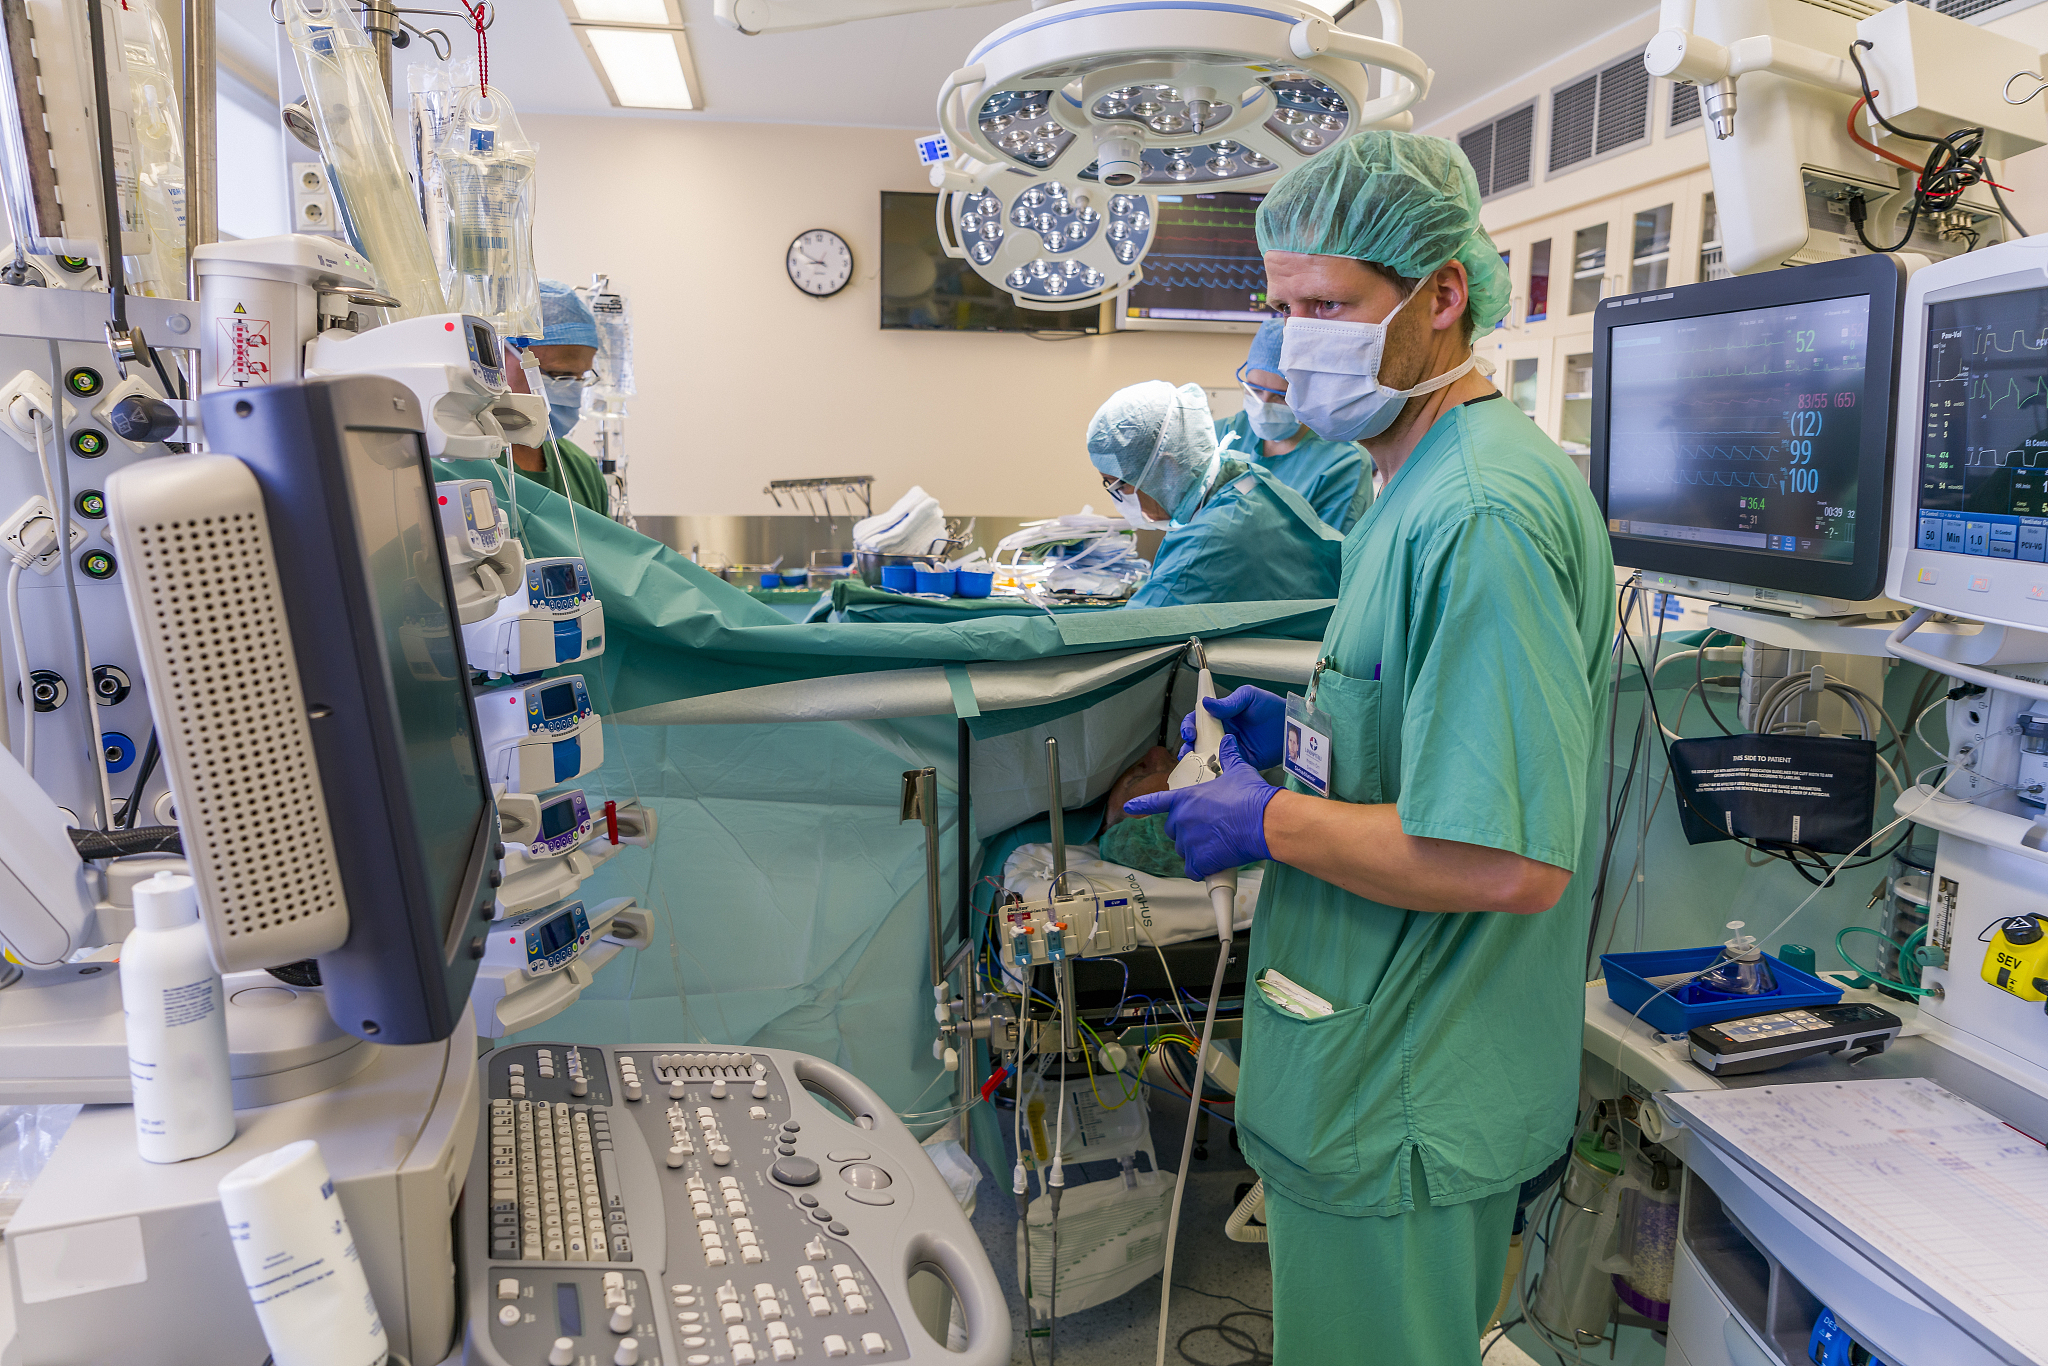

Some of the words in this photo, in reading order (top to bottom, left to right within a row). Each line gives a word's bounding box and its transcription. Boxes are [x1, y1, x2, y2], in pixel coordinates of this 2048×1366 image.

[1796, 330, 1816, 353] 52
[1798, 393, 1828, 409] 83/55
[1834, 392, 1856, 408] (65)
[1790, 411, 1822, 437] (12)
[1790, 440, 1812, 465] 99
[1788, 468, 1819, 494] 100
[1747, 497, 1766, 510] 36.4
[1824, 506, 1843, 518] 00:39
[1750, 515, 1758, 525] 31
[1925, 530, 1935, 540] 50
[1946, 532, 1960, 543] Min
[1970, 535, 1983, 545] 1.0
[2021, 541, 2043, 551] PCV-VG
[1767, 755, 1792, 763] PATIENT
[1996, 952, 2022, 970] SEV
[1823, 1316, 1838, 1332] DES
